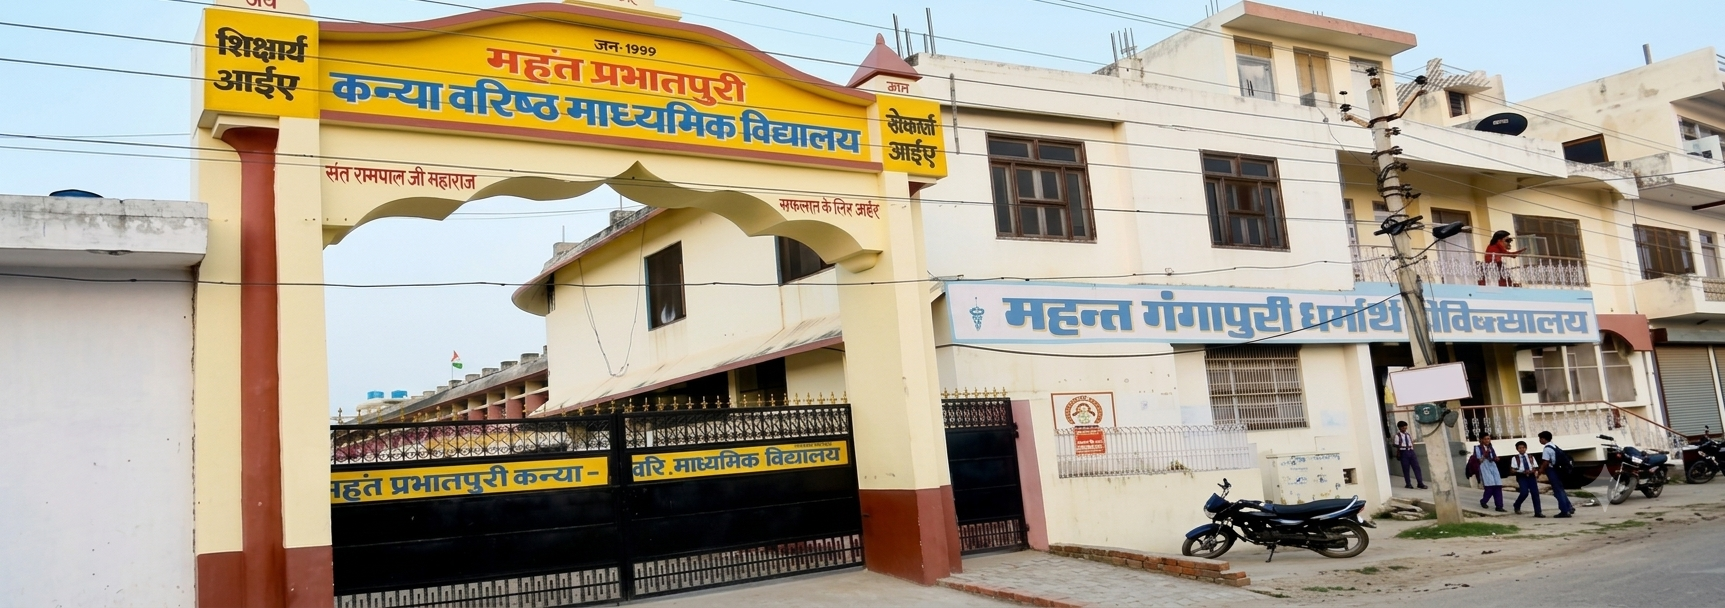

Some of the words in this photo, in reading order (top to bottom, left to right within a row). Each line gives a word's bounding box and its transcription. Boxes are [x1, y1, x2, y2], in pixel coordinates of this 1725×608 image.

[625, 43, 657, 56] 1999
[213, 66, 300, 101] आईए
[487, 48, 582, 83] महंत
[591, 61, 745, 106] प्रभातपुरी
[329, 72, 443, 111] कन्या
[449, 79, 560, 121] वरिष्ठ
[566, 97, 736, 140] माध्यमिक
[741, 109, 861, 153] विद्यालय
[325, 162, 353, 184] संत
[354, 167, 406, 187] रामपाल
[407, 166, 426, 187] जी
[428, 172, 477, 190] महाराज
[1002, 297, 1133, 336] महन्त
[1141, 290, 1293, 338] गंगापुरी
[764, 446, 841, 467] विद्यालय
[389, 464, 509, 496] प्रभातपुरी
[513, 465, 584, 486] कन्या
